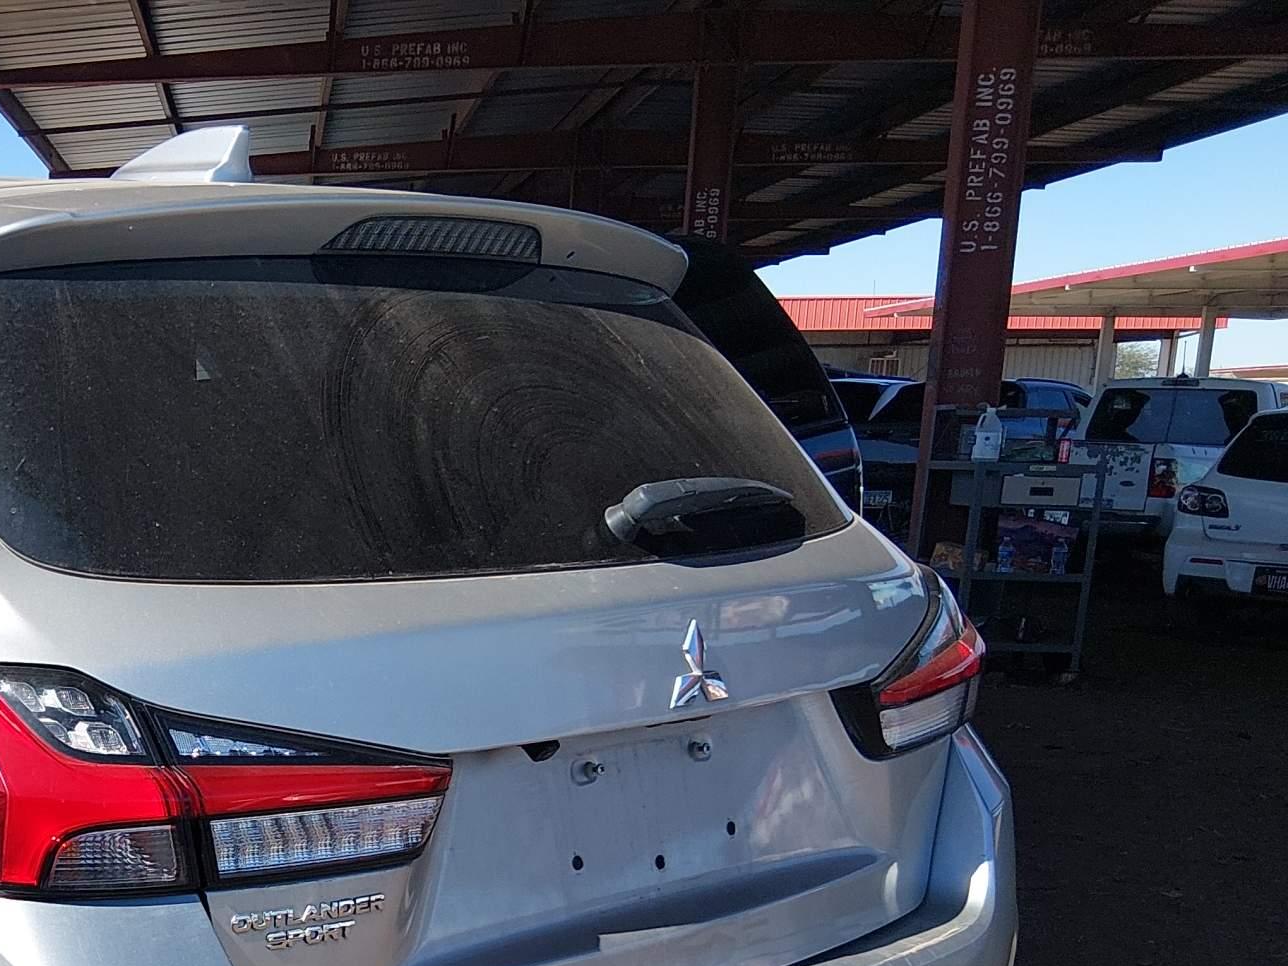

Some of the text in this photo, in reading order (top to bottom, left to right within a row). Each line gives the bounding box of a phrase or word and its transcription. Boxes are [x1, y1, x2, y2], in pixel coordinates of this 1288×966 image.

[391, 42, 441, 56] PREFAB
[959, 66, 997, 253] U.S. PREFAB INC.
[980, 67, 1017, 251] 1-866-799-0969
[231, 892, 385, 934] OUTLANDER
[265, 920, 357, 951] SPORT
